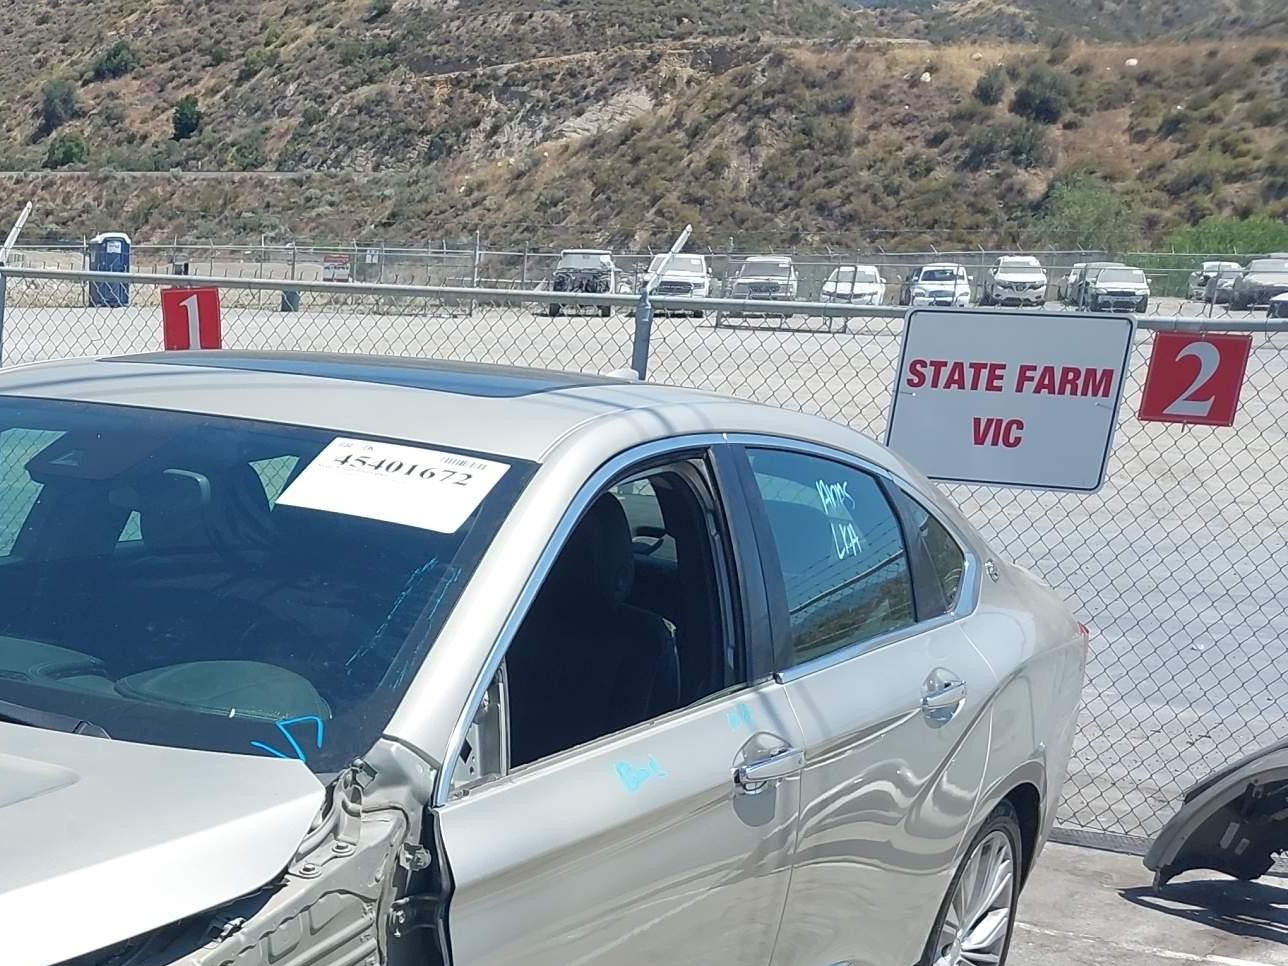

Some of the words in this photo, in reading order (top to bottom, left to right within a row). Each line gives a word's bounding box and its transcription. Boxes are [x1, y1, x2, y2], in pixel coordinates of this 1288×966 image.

[178, 294, 202, 350] 1
[905, 358, 1007, 393] STATE
[1014, 363, 1116, 398] FARM
[1162, 340, 1222, 418] 2
[971, 416, 1025, 449] VIC
[333, 453, 474, 487] 45401672
